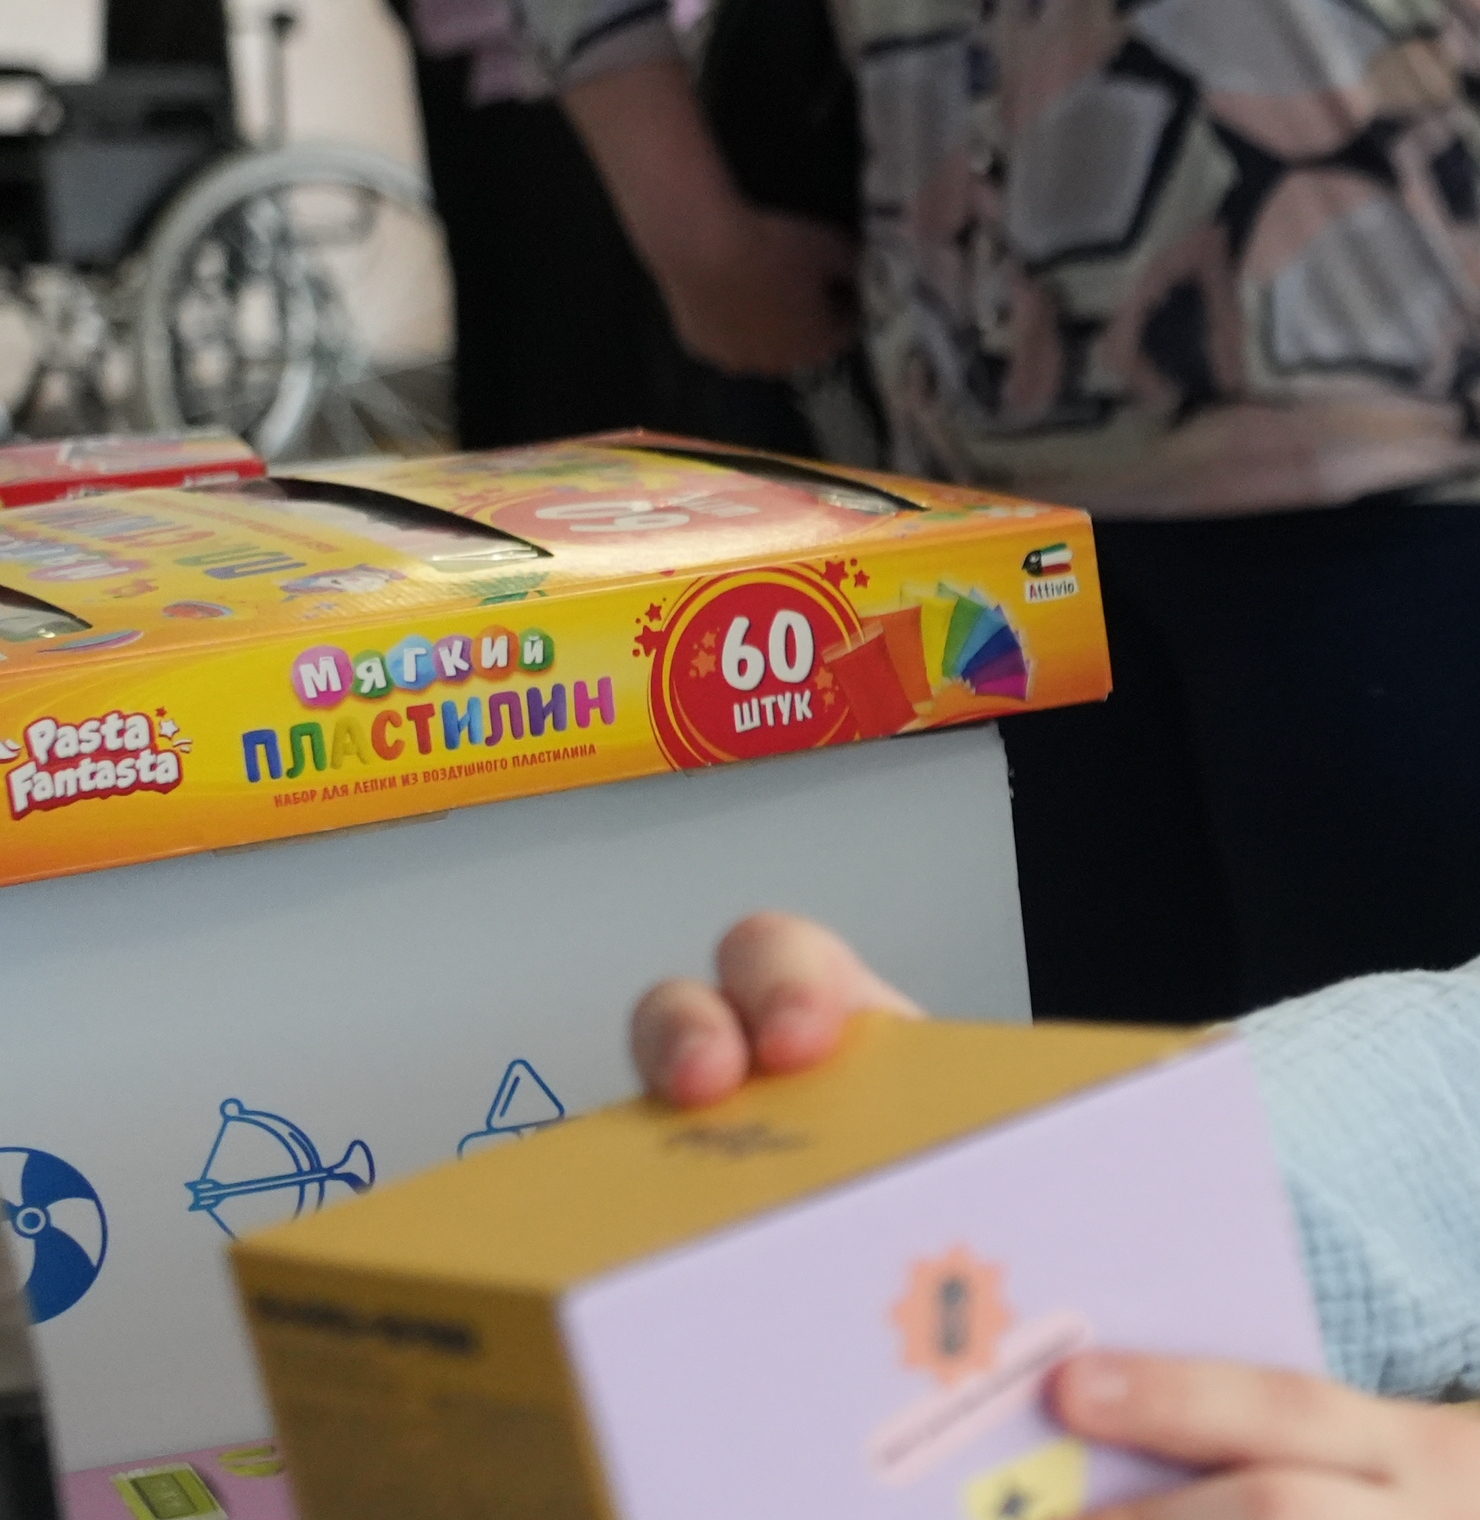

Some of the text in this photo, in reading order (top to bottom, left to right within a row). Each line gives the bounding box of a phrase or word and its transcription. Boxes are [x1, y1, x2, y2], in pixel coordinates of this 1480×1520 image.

[1028, 581, 1076, 601] Attivio
[721, 609, 815, 691] 60
[29, 714, 150, 765] Pasta
[242, 675, 615, 783] ПЛАСТИЛИН
[732, 690, 814, 733] ШТУК
[10, 750, 180, 814] Fantasta
[274, 743, 597, 808] НАБОР ДЛЯ ЛЕПКИ ИЗ ВОЗДУШНОГО ПЛАСТИЛИНА
